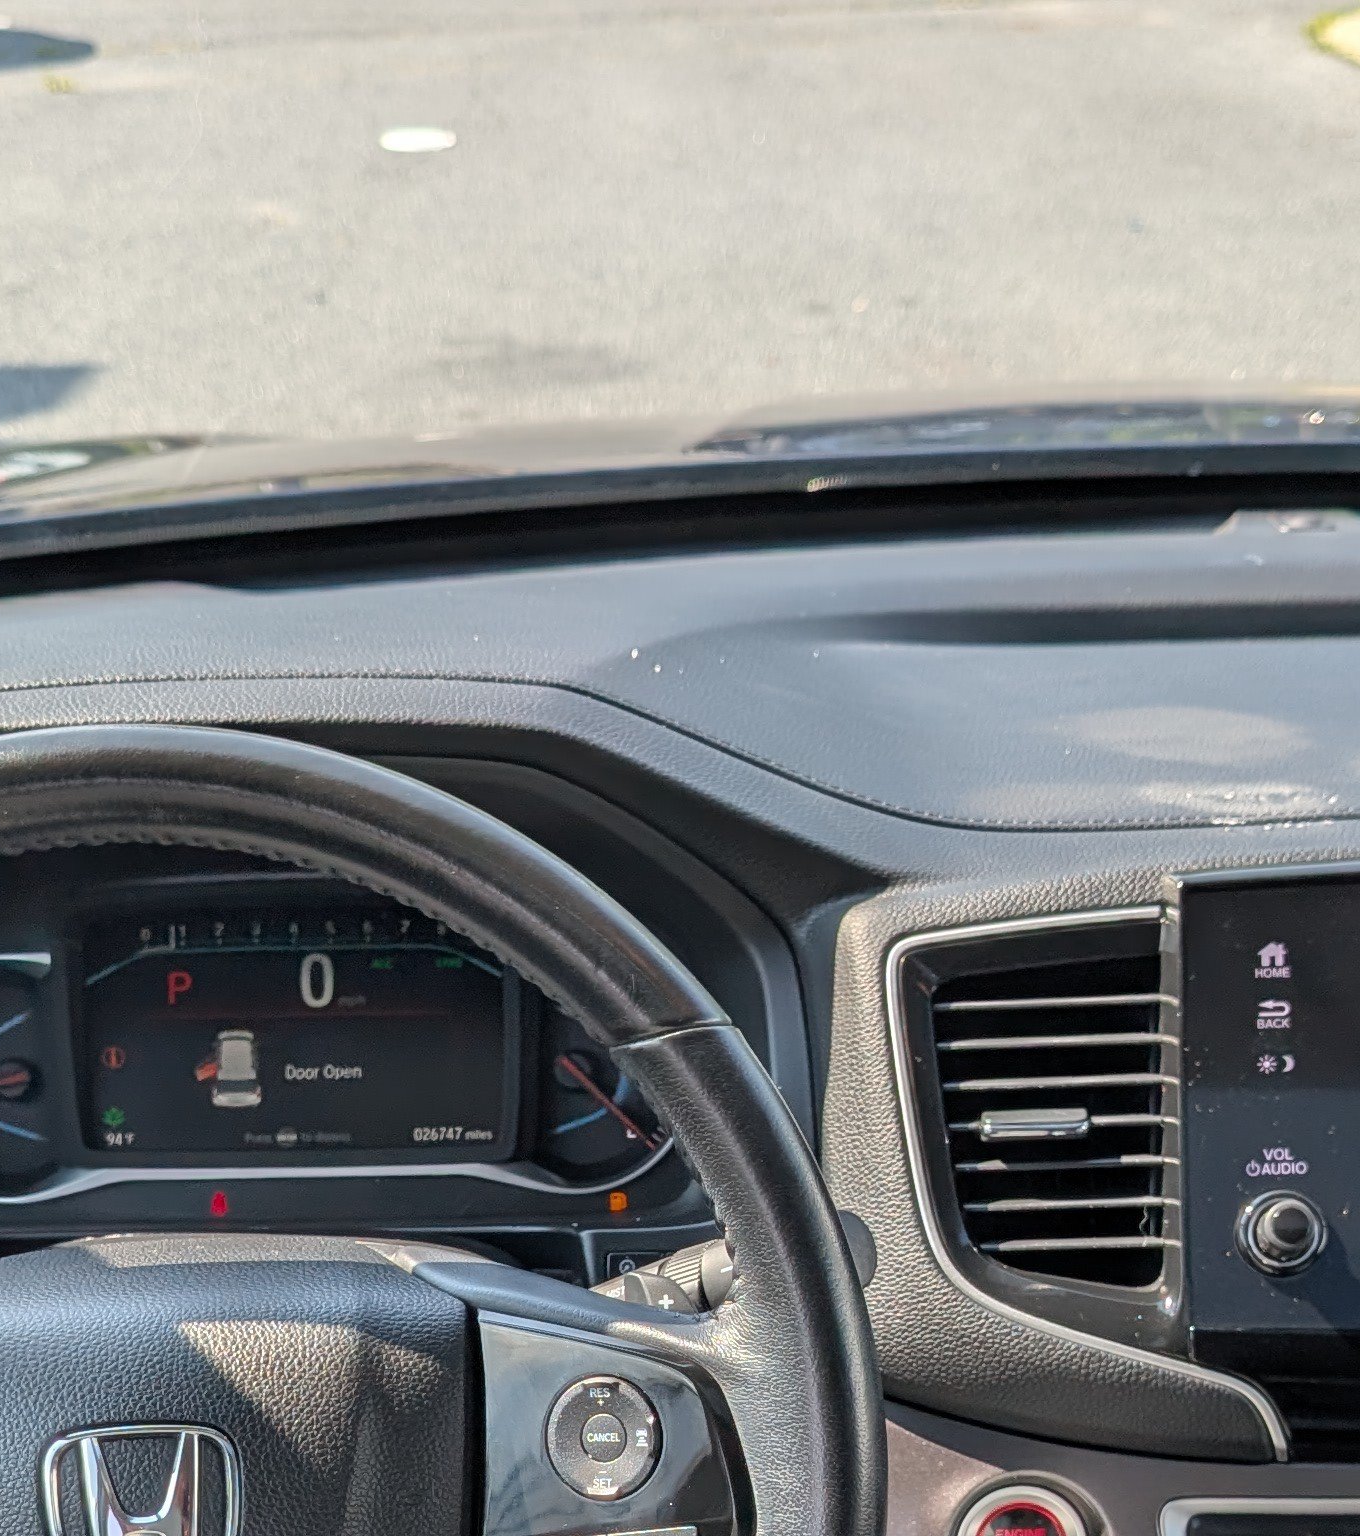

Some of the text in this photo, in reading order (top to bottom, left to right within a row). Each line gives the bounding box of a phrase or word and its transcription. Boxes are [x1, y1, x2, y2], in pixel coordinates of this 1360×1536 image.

[1254, 967, 1292, 979] HOME
[167, 969, 193, 1005] P
[300, 953, 335, 1008] 0
[1257, 1018, 1291, 1030] BACK
[285, 1064, 363, 1082] Door Open
[413, 1126, 493, 1143] 026747 miles
[1262, 1147, 1295, 1161] VOL
[1261, 1160, 1308, 1176] AUDIO
[589, 1387, 611, 1398] RES
[586, 1432, 621, 1443] CANCEL
[592, 1478, 613, 1488] SET
